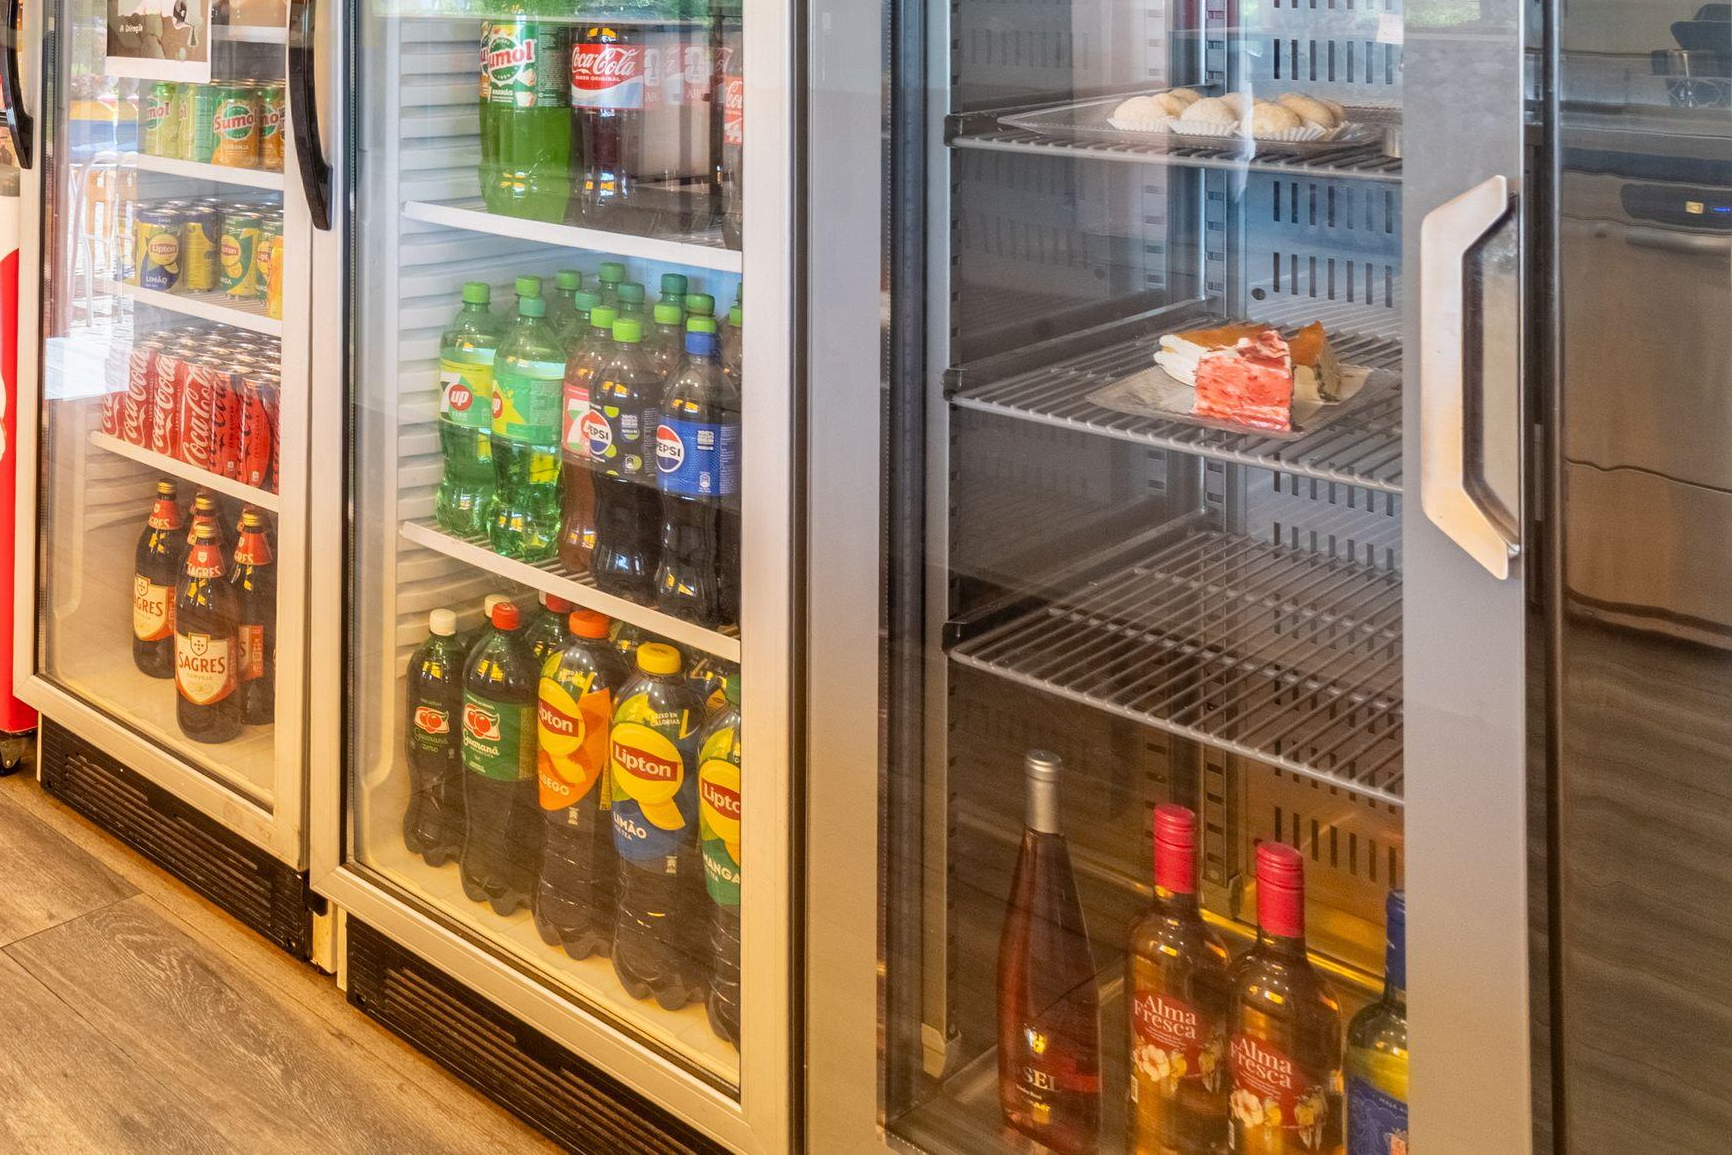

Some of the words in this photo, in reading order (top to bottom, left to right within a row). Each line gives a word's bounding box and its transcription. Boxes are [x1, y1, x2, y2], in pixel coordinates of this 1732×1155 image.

[571, 46, 642, 76] Coca-Cola
[658, 443, 681, 457] EPSI
[134, 596, 164, 618] AGRES
[178, 651, 226, 675] SAGRES
[539, 700, 574, 734] ipton
[615, 745, 672, 778] Lipton
[703, 783, 740, 813] Lipto
[613, 811, 647, 839] LIMÃO
[1134, 999, 1197, 1040] Fresca
[1143, 995, 1196, 1026] Alma
[1231, 1042, 1292, 1090] Fresca
[1237, 1038, 1292, 1075] Alma
